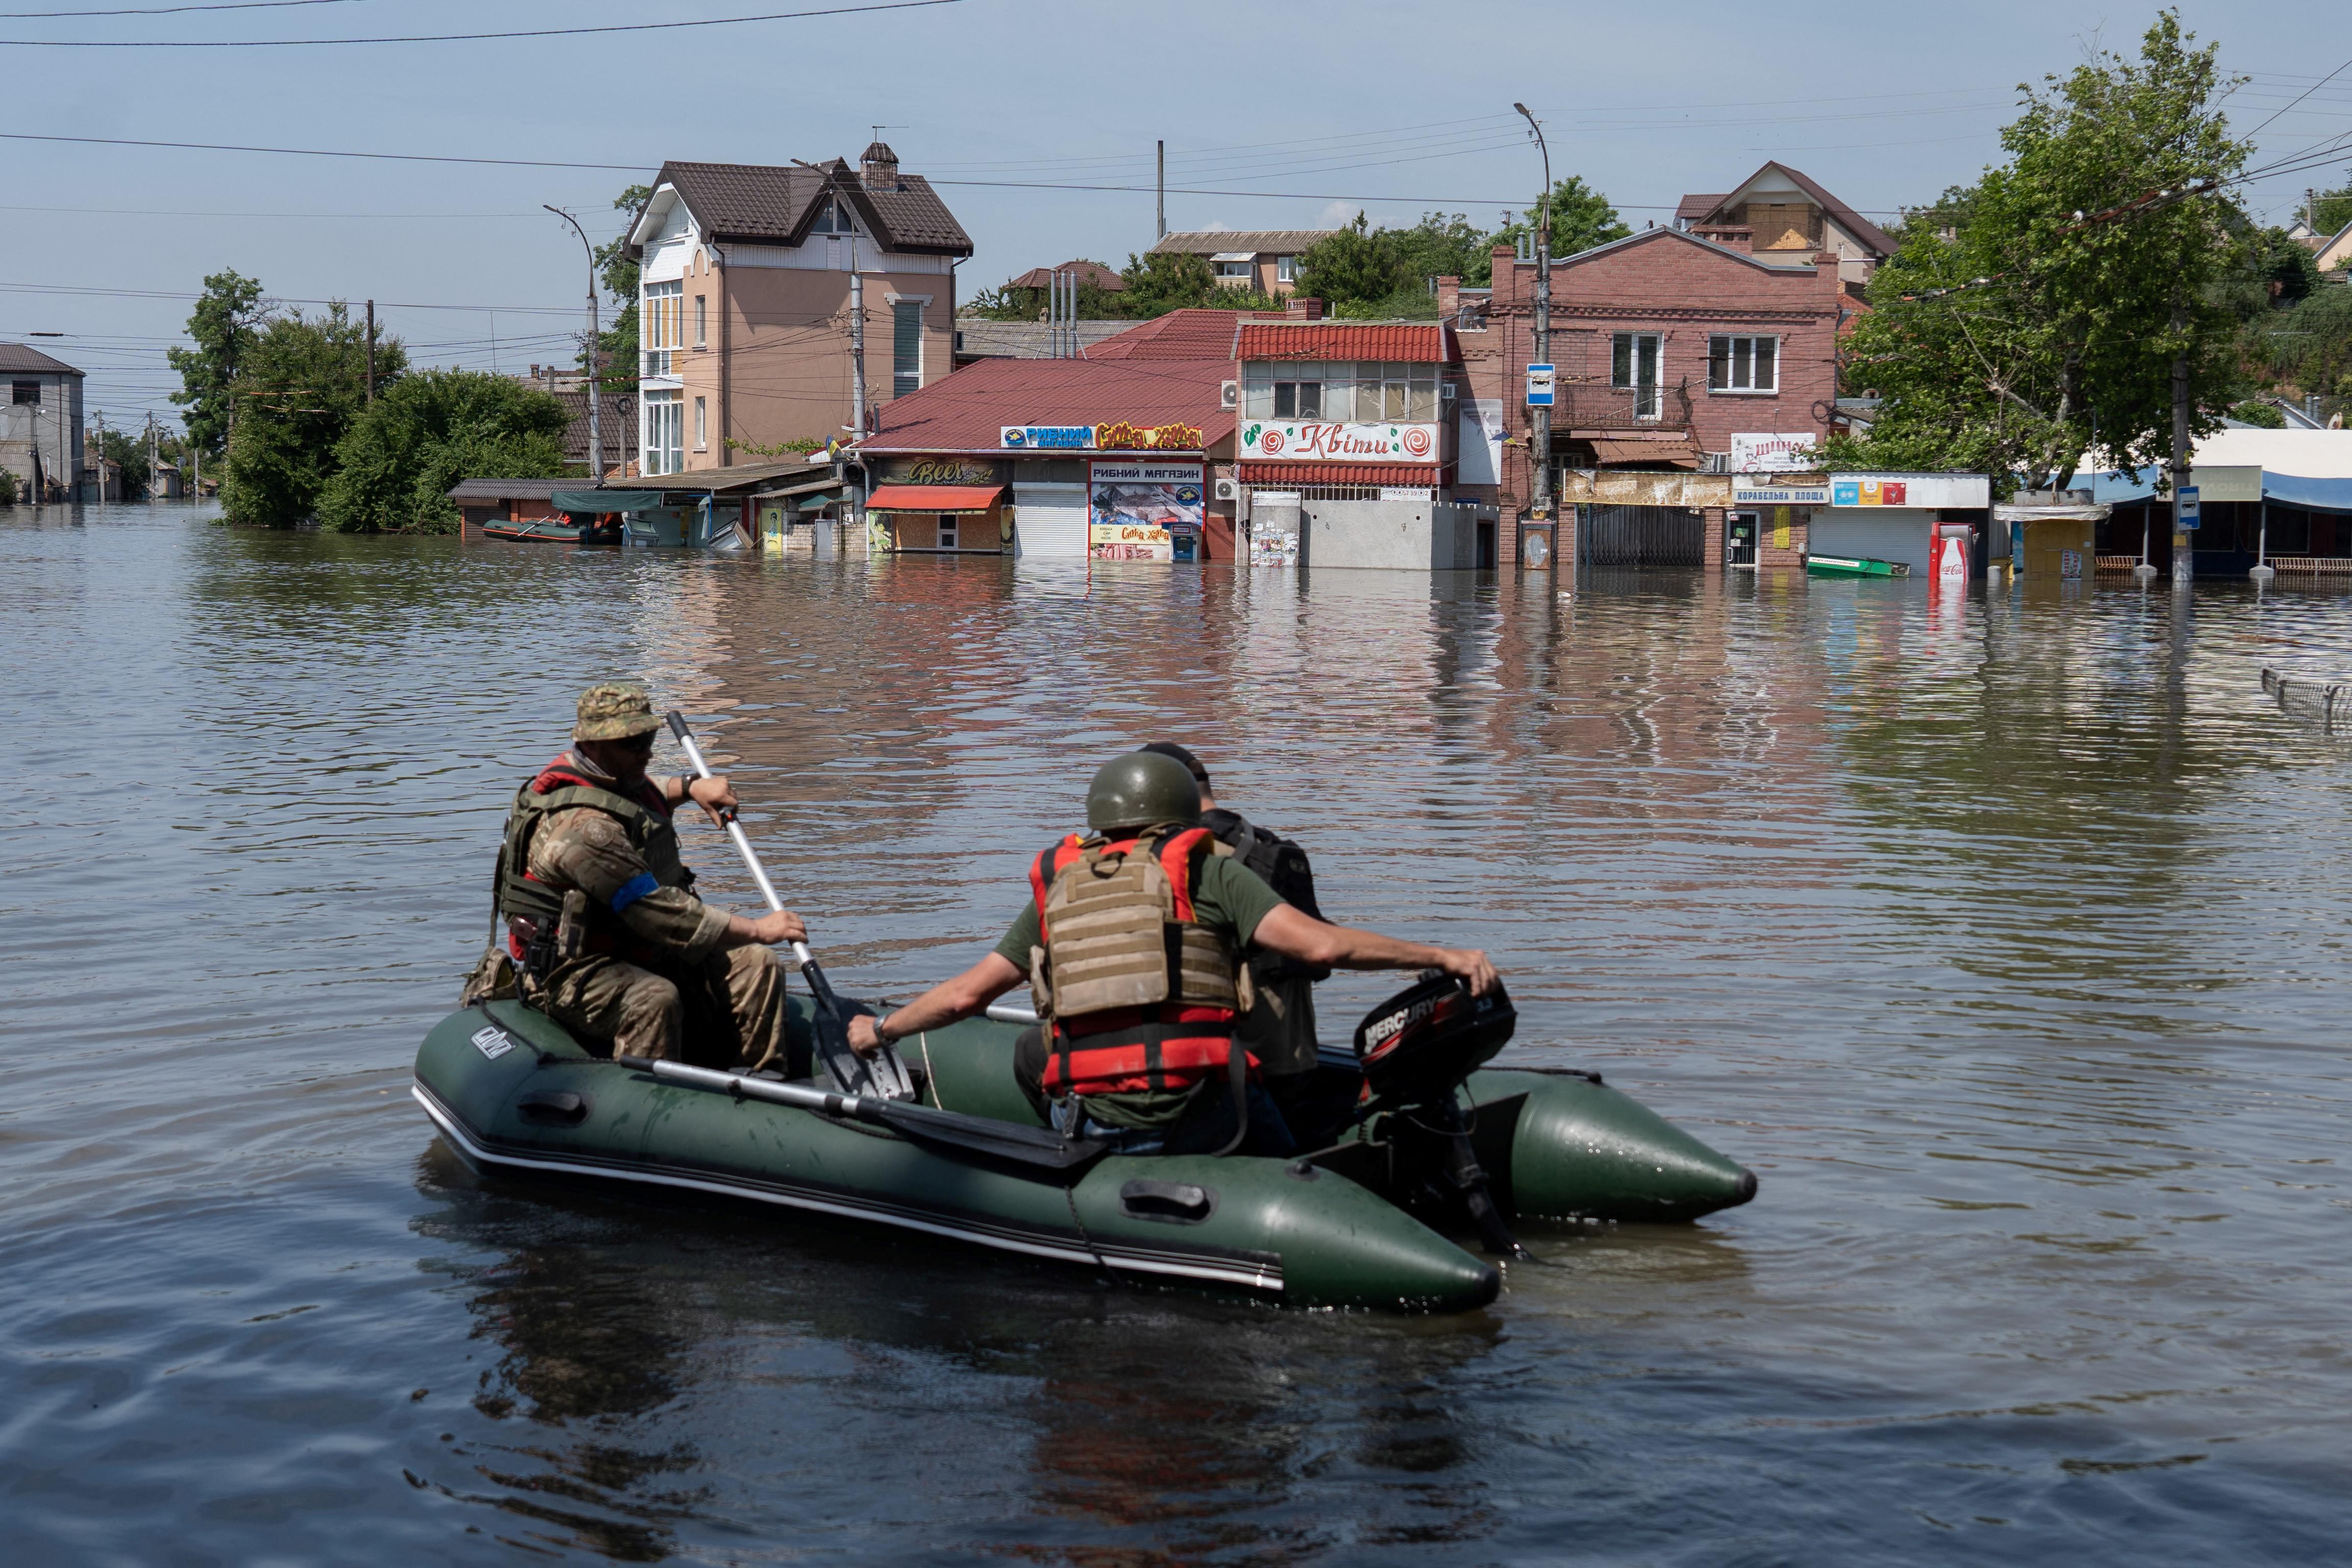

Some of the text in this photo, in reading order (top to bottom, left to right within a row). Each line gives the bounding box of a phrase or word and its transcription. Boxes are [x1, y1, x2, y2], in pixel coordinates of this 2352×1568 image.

[1026, 427, 1092, 439] РИБНИЙ
[1294, 424, 1389, 458] Квіти
[908, 459, 963, 484] Beer
[1093, 468, 1199, 478] РИБНИЙ МАГАЗИН
[1737, 492, 1824, 501] КОРАБЕЛЬНА ПЛОЩА
[1364, 996, 1438, 1054] MERCURY
